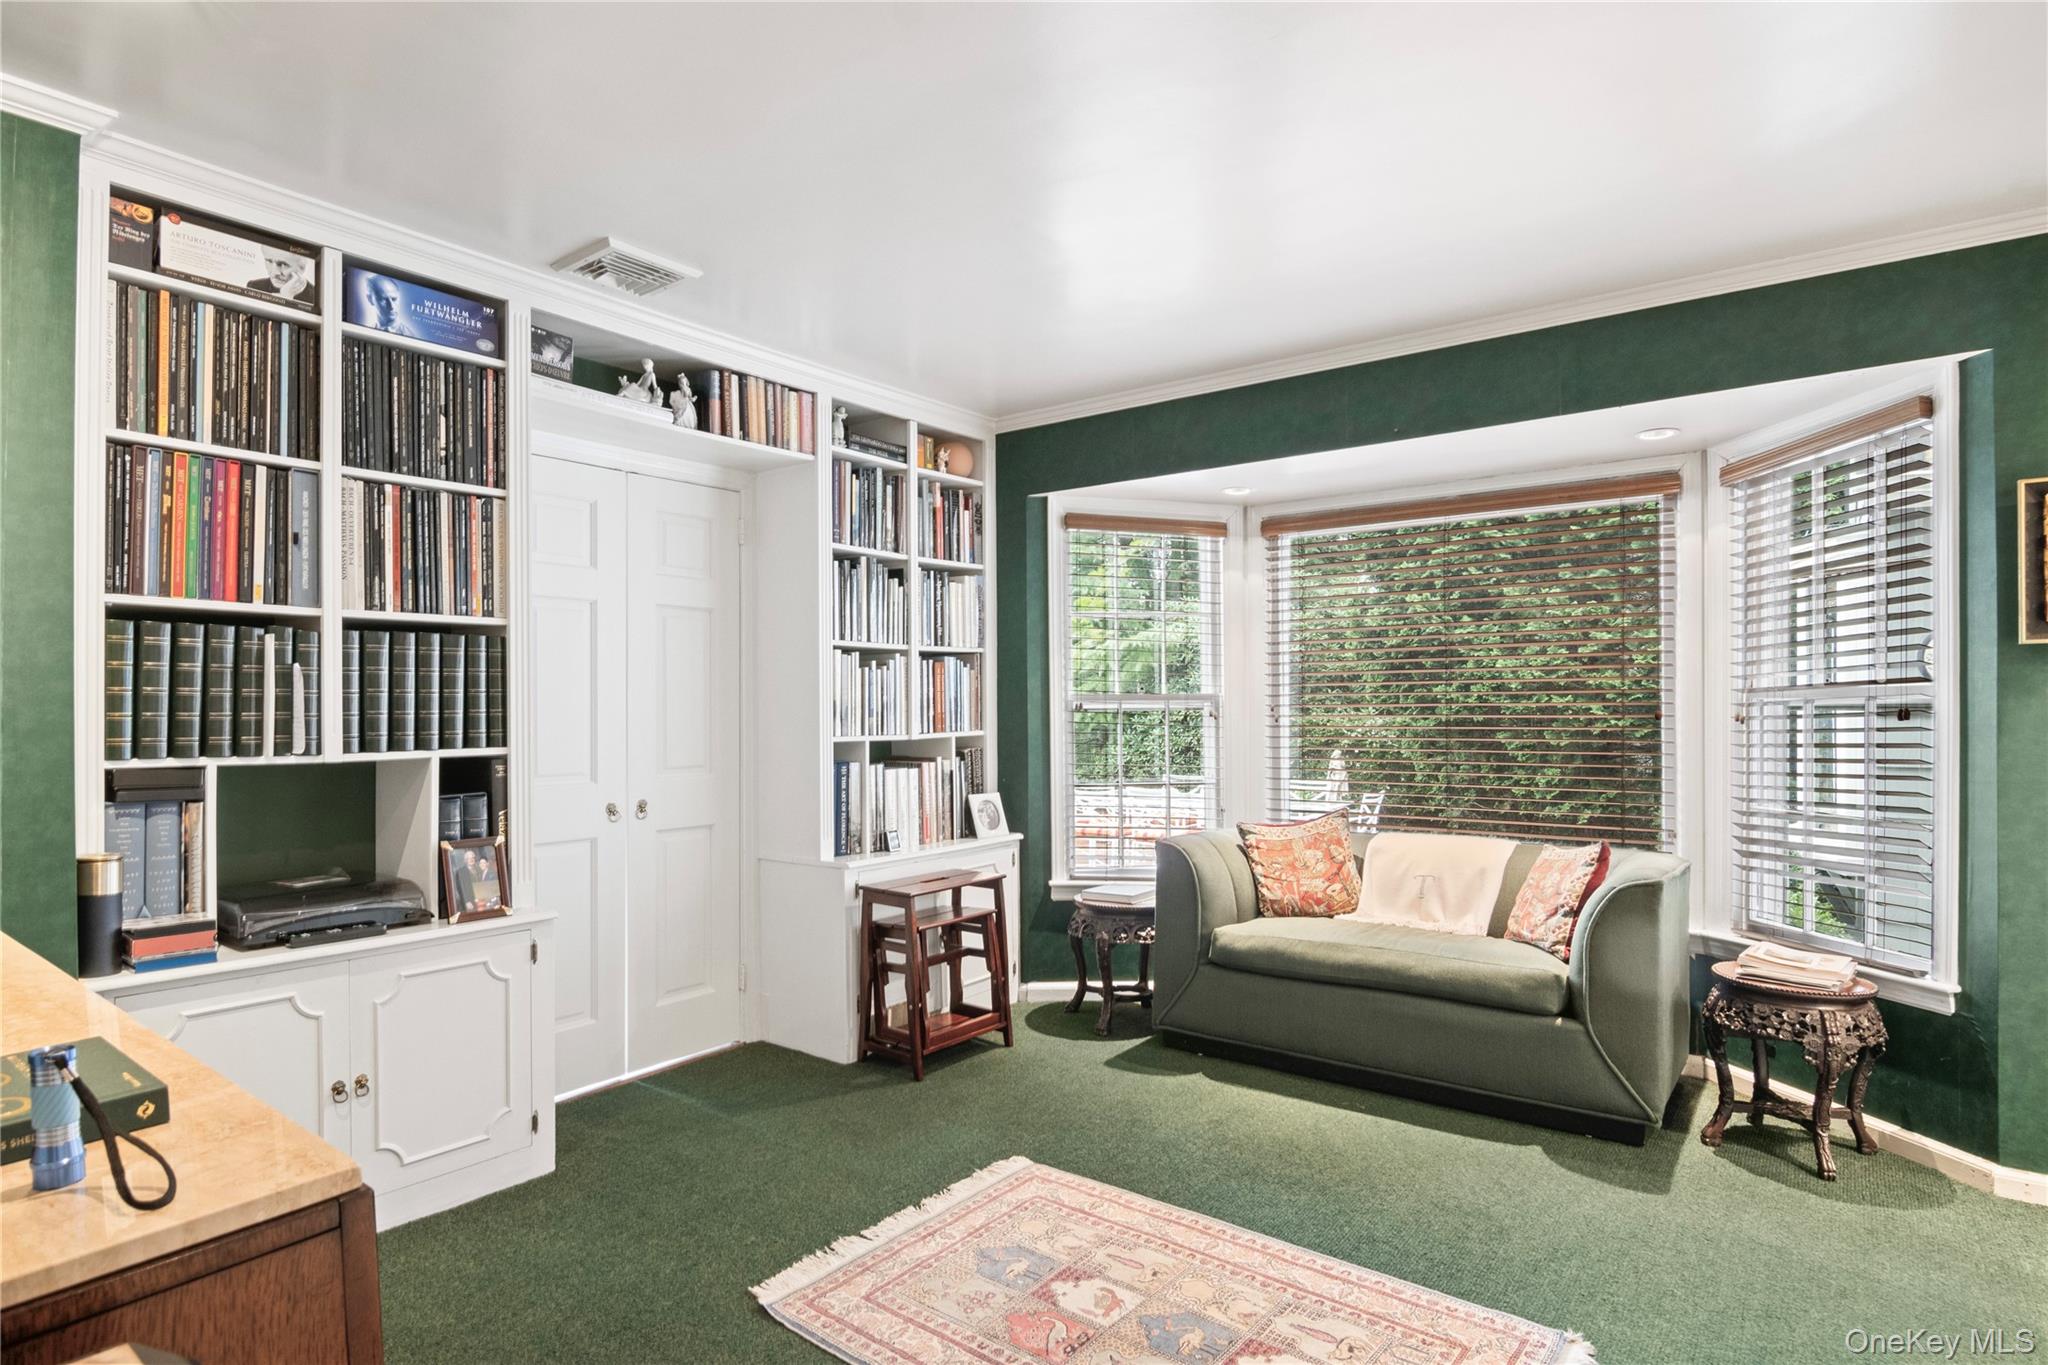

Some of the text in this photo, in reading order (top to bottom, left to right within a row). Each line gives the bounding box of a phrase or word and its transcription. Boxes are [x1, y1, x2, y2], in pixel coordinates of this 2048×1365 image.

[170, 231, 256, 259] ARTURO TOSCANINI
[424, 300, 470, 318] WILHELM
